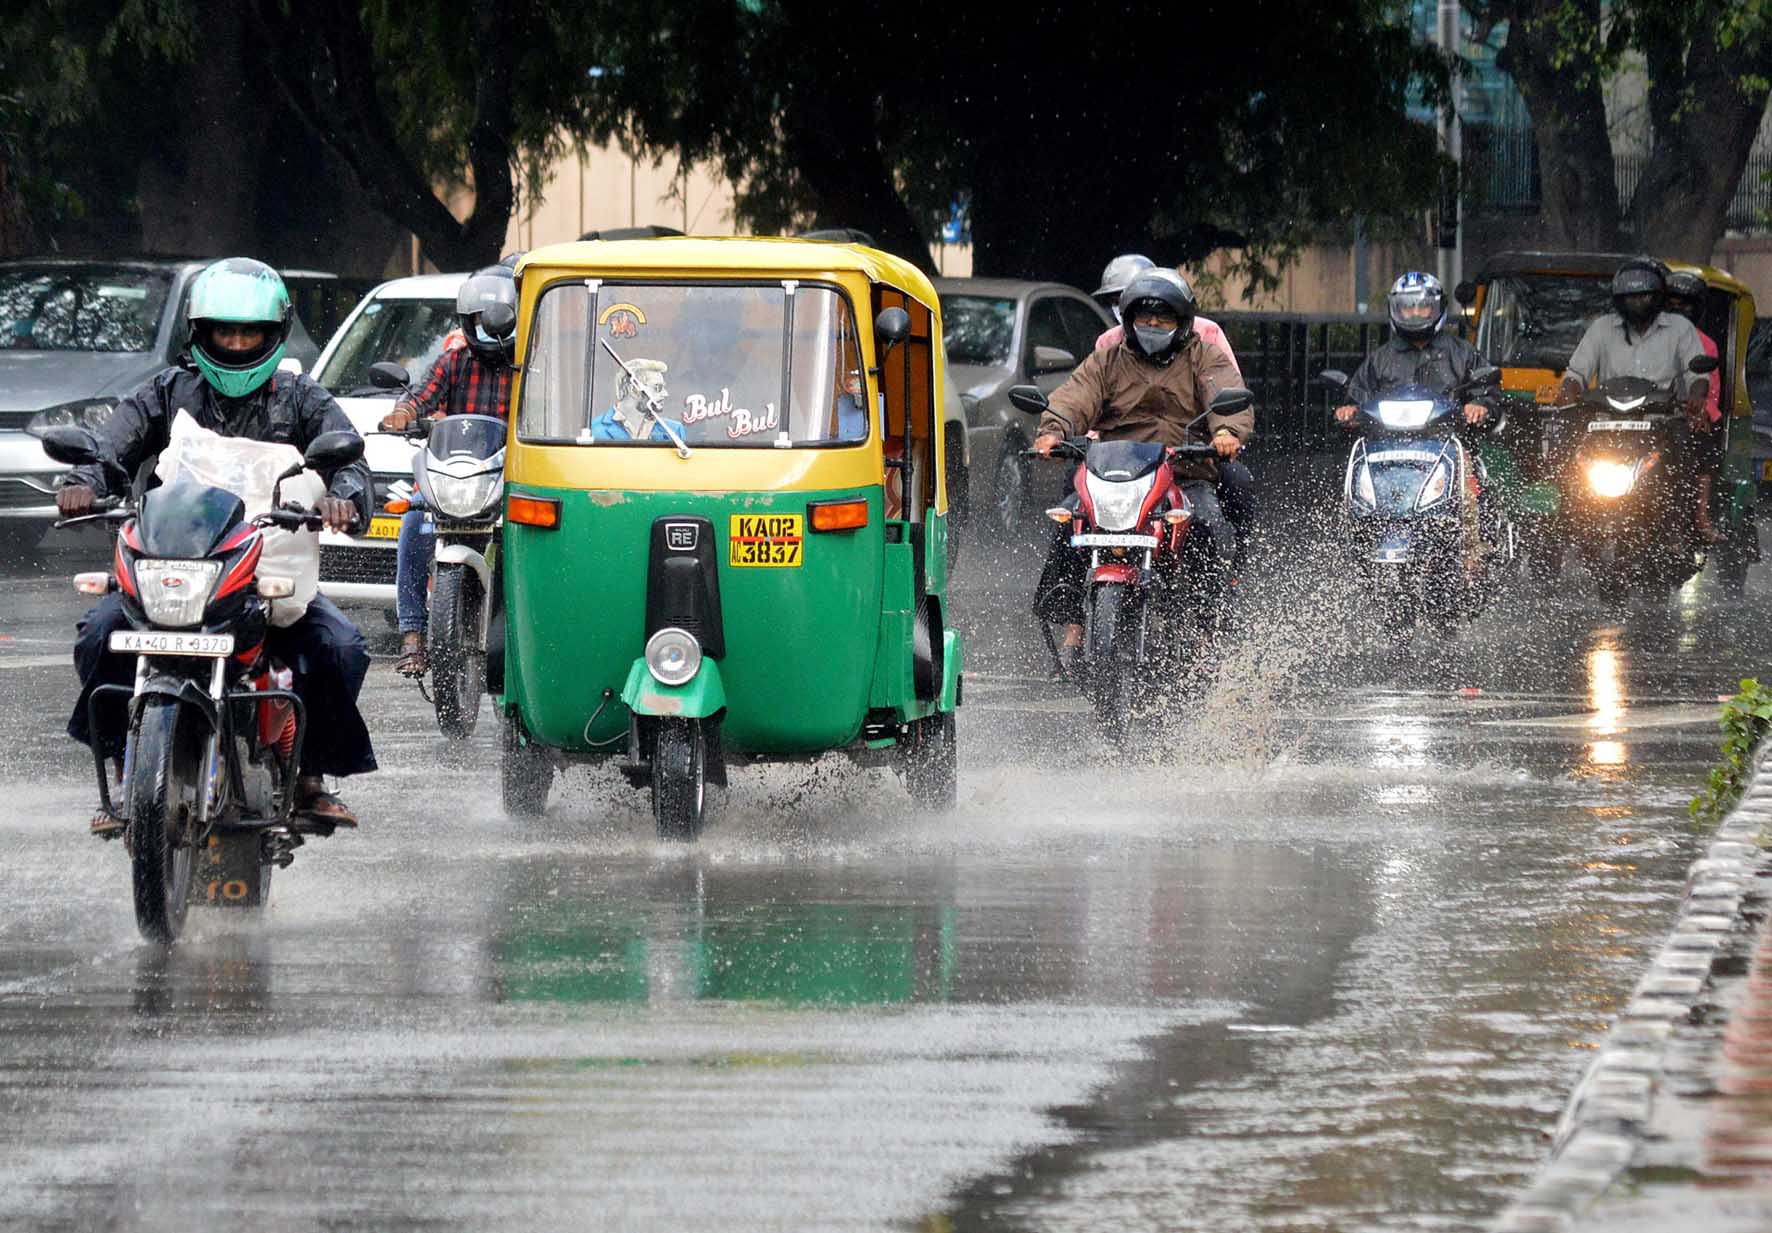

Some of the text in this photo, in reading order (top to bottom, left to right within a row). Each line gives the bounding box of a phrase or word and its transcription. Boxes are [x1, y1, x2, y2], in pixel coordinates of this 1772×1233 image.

[683, 387, 734, 424] Bul
[727, 403, 778, 438] Bul
[671, 532, 692, 545] RE
[739, 518, 795, 537] KA02
[742, 541, 799, 563] 3837
